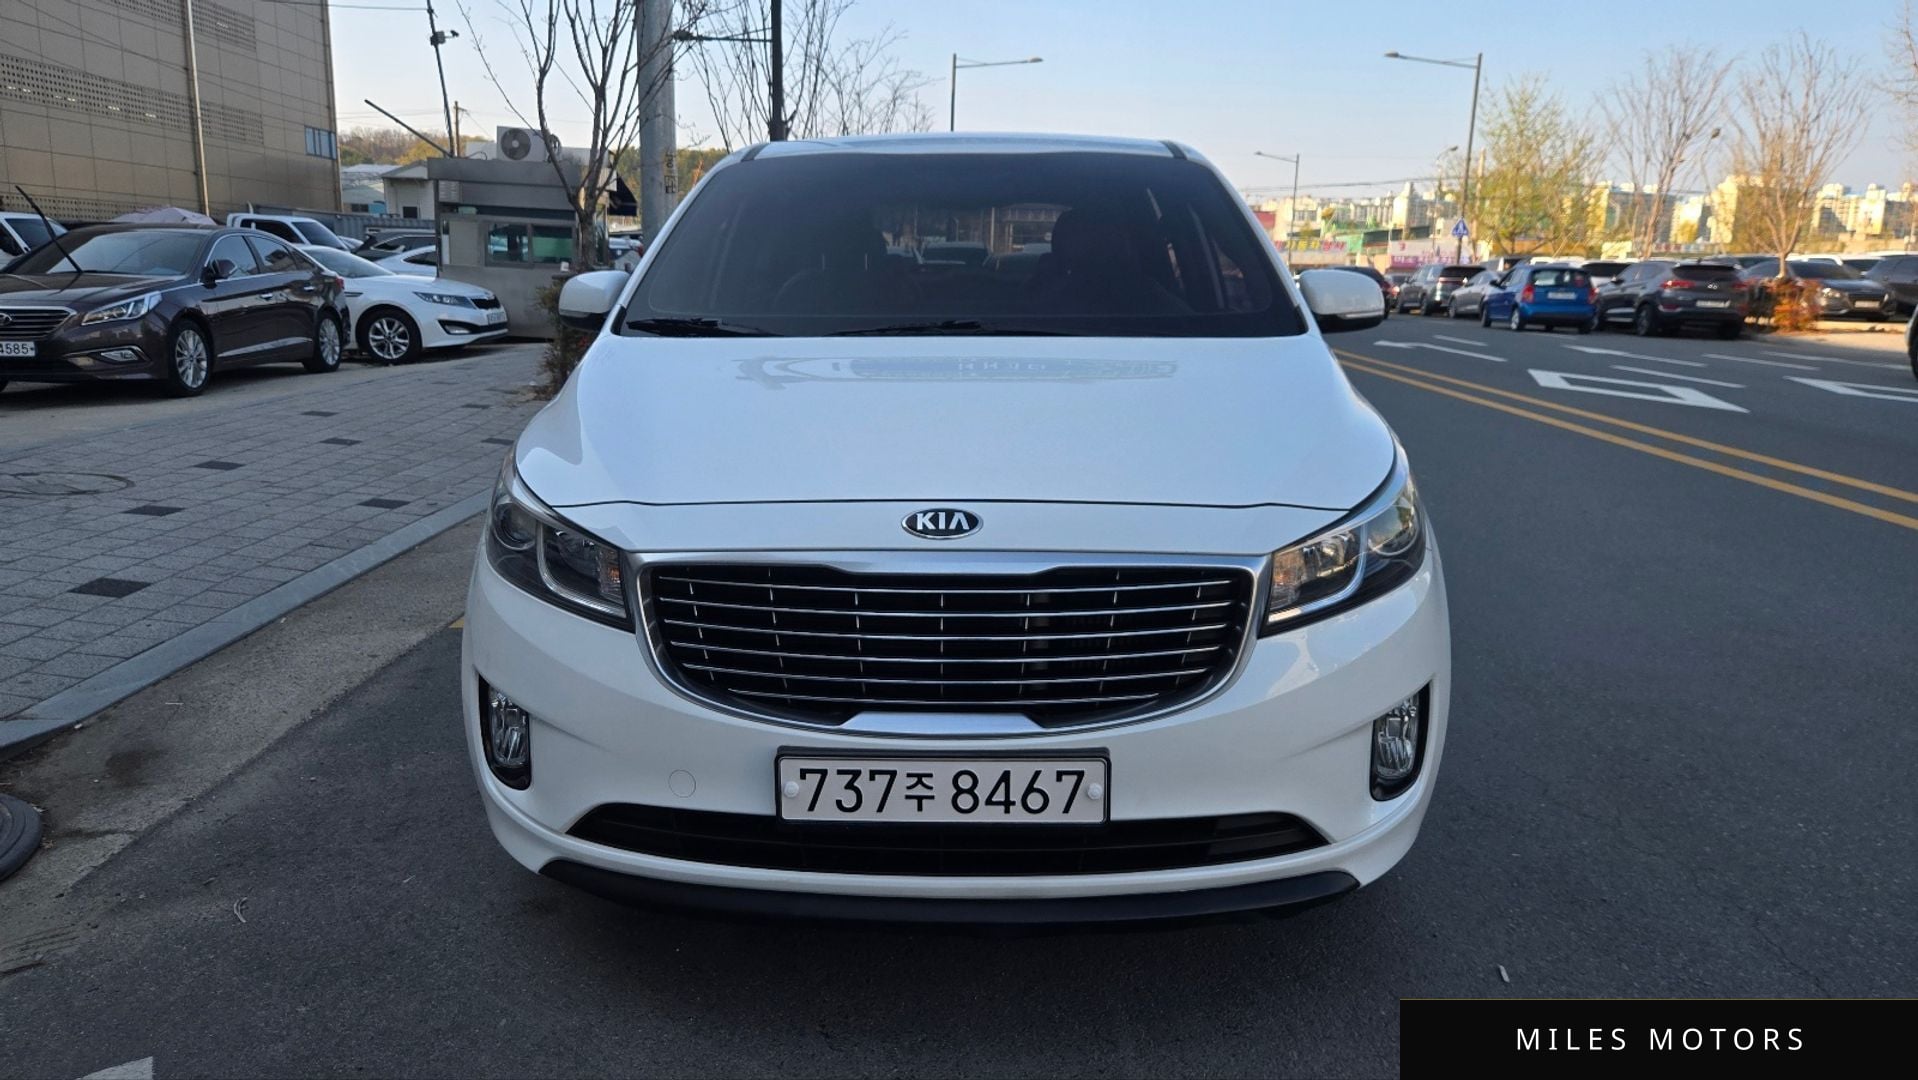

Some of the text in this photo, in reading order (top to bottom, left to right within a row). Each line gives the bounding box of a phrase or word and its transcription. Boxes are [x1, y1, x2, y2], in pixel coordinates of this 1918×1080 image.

[916, 511, 970, 530] KIA
[799, 767, 1086, 815] 737주 8467
